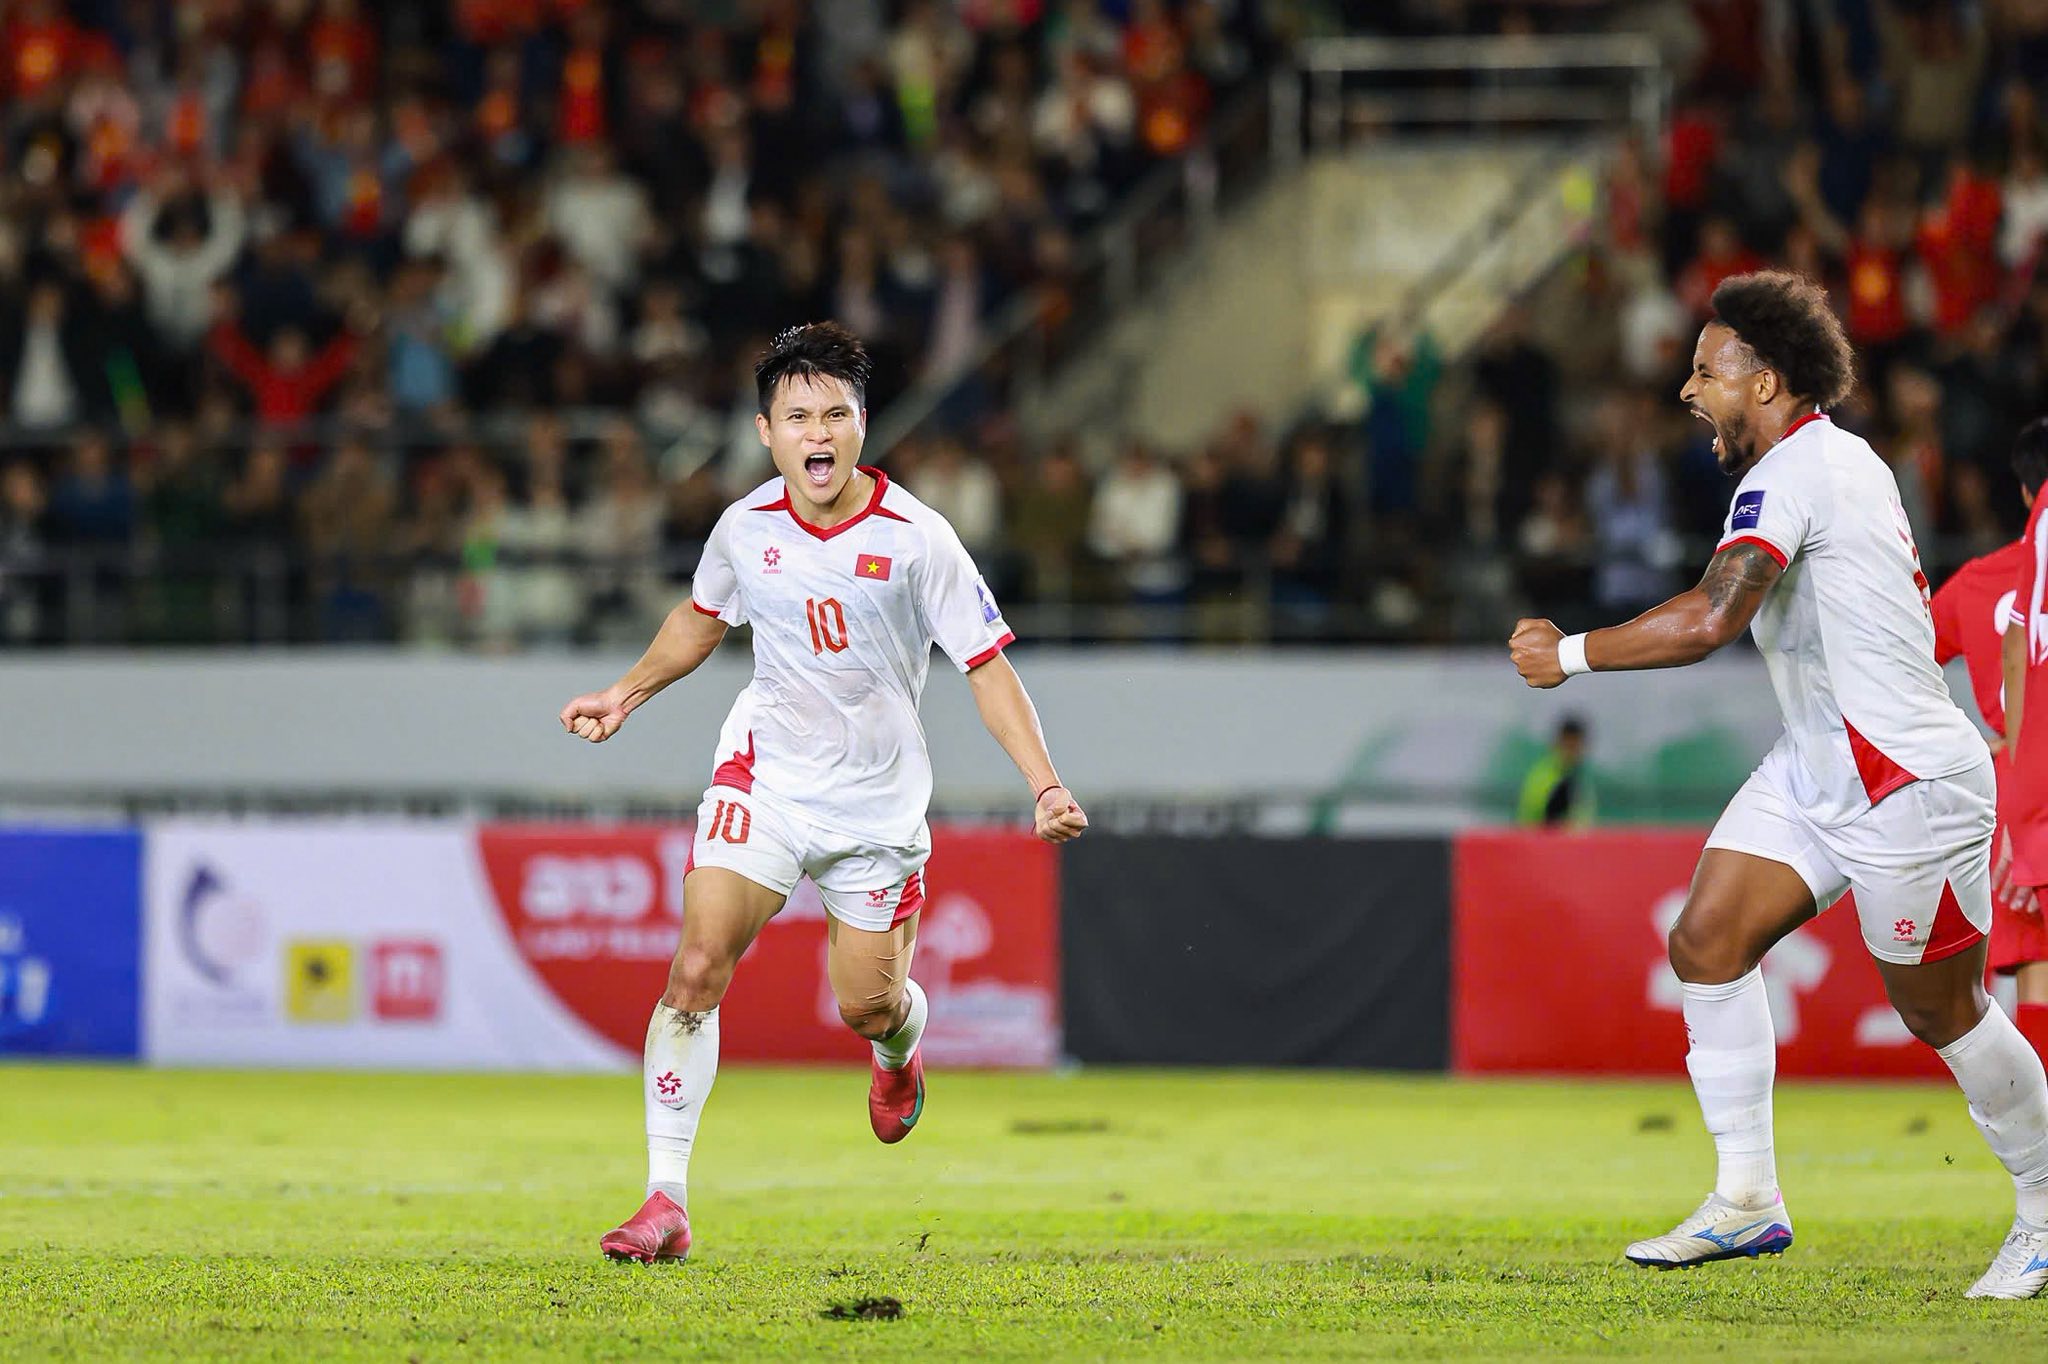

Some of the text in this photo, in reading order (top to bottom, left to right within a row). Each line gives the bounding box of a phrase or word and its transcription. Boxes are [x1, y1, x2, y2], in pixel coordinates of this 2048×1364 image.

[1734, 504, 1761, 516] AFC
[806, 597, 849, 656] 10
[707, 799, 751, 844] 10
